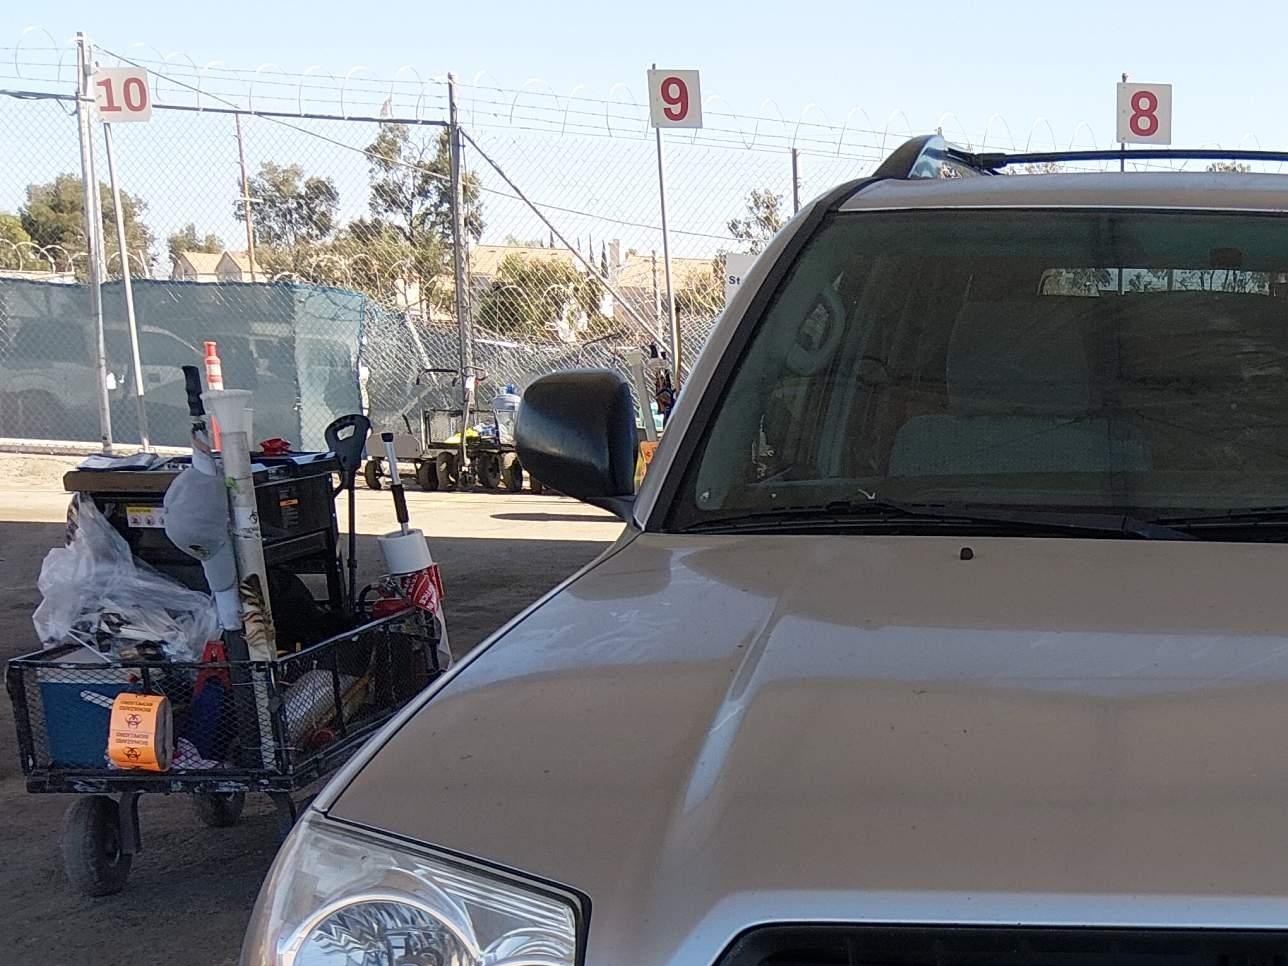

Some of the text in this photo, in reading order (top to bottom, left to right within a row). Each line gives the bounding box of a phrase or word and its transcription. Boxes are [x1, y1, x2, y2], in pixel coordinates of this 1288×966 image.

[96, 75, 148, 114] 10
[661, 77, 689, 122] 9
[1130, 91, 1158, 136] 8
